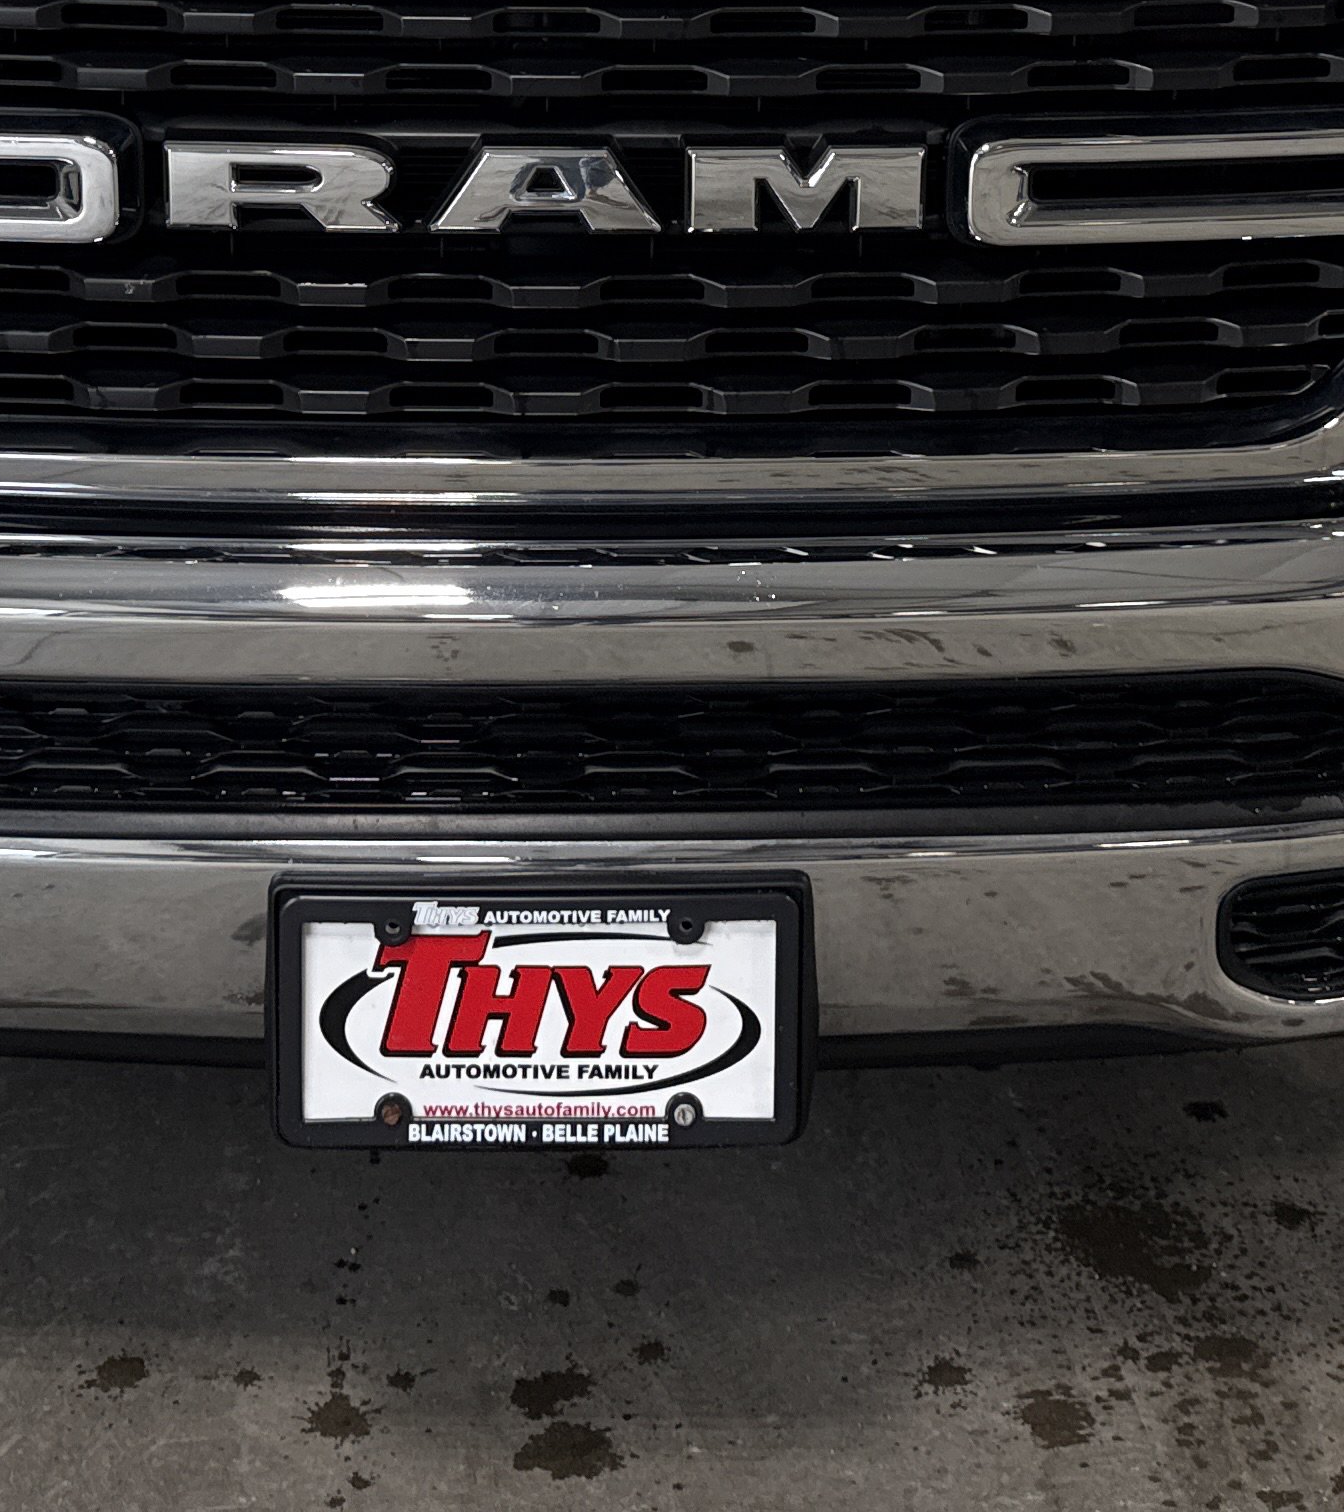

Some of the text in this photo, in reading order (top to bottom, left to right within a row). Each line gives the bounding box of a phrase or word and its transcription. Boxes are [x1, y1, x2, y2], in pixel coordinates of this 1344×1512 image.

[164, 139, 927, 234] RAM
[484, 910, 602, 924] AUTOMOTIVE
[607, 909, 671, 923] FAMILY
[374, 930, 711, 1058] THYS
[419, 1064, 659, 1080] AUTOMOTIVE FAMILY
[423, 1101, 656, 1118] www.thysautofamily.com
[408, 1123, 669, 1142] BLAIRSTOWN BELLE PLAINE
